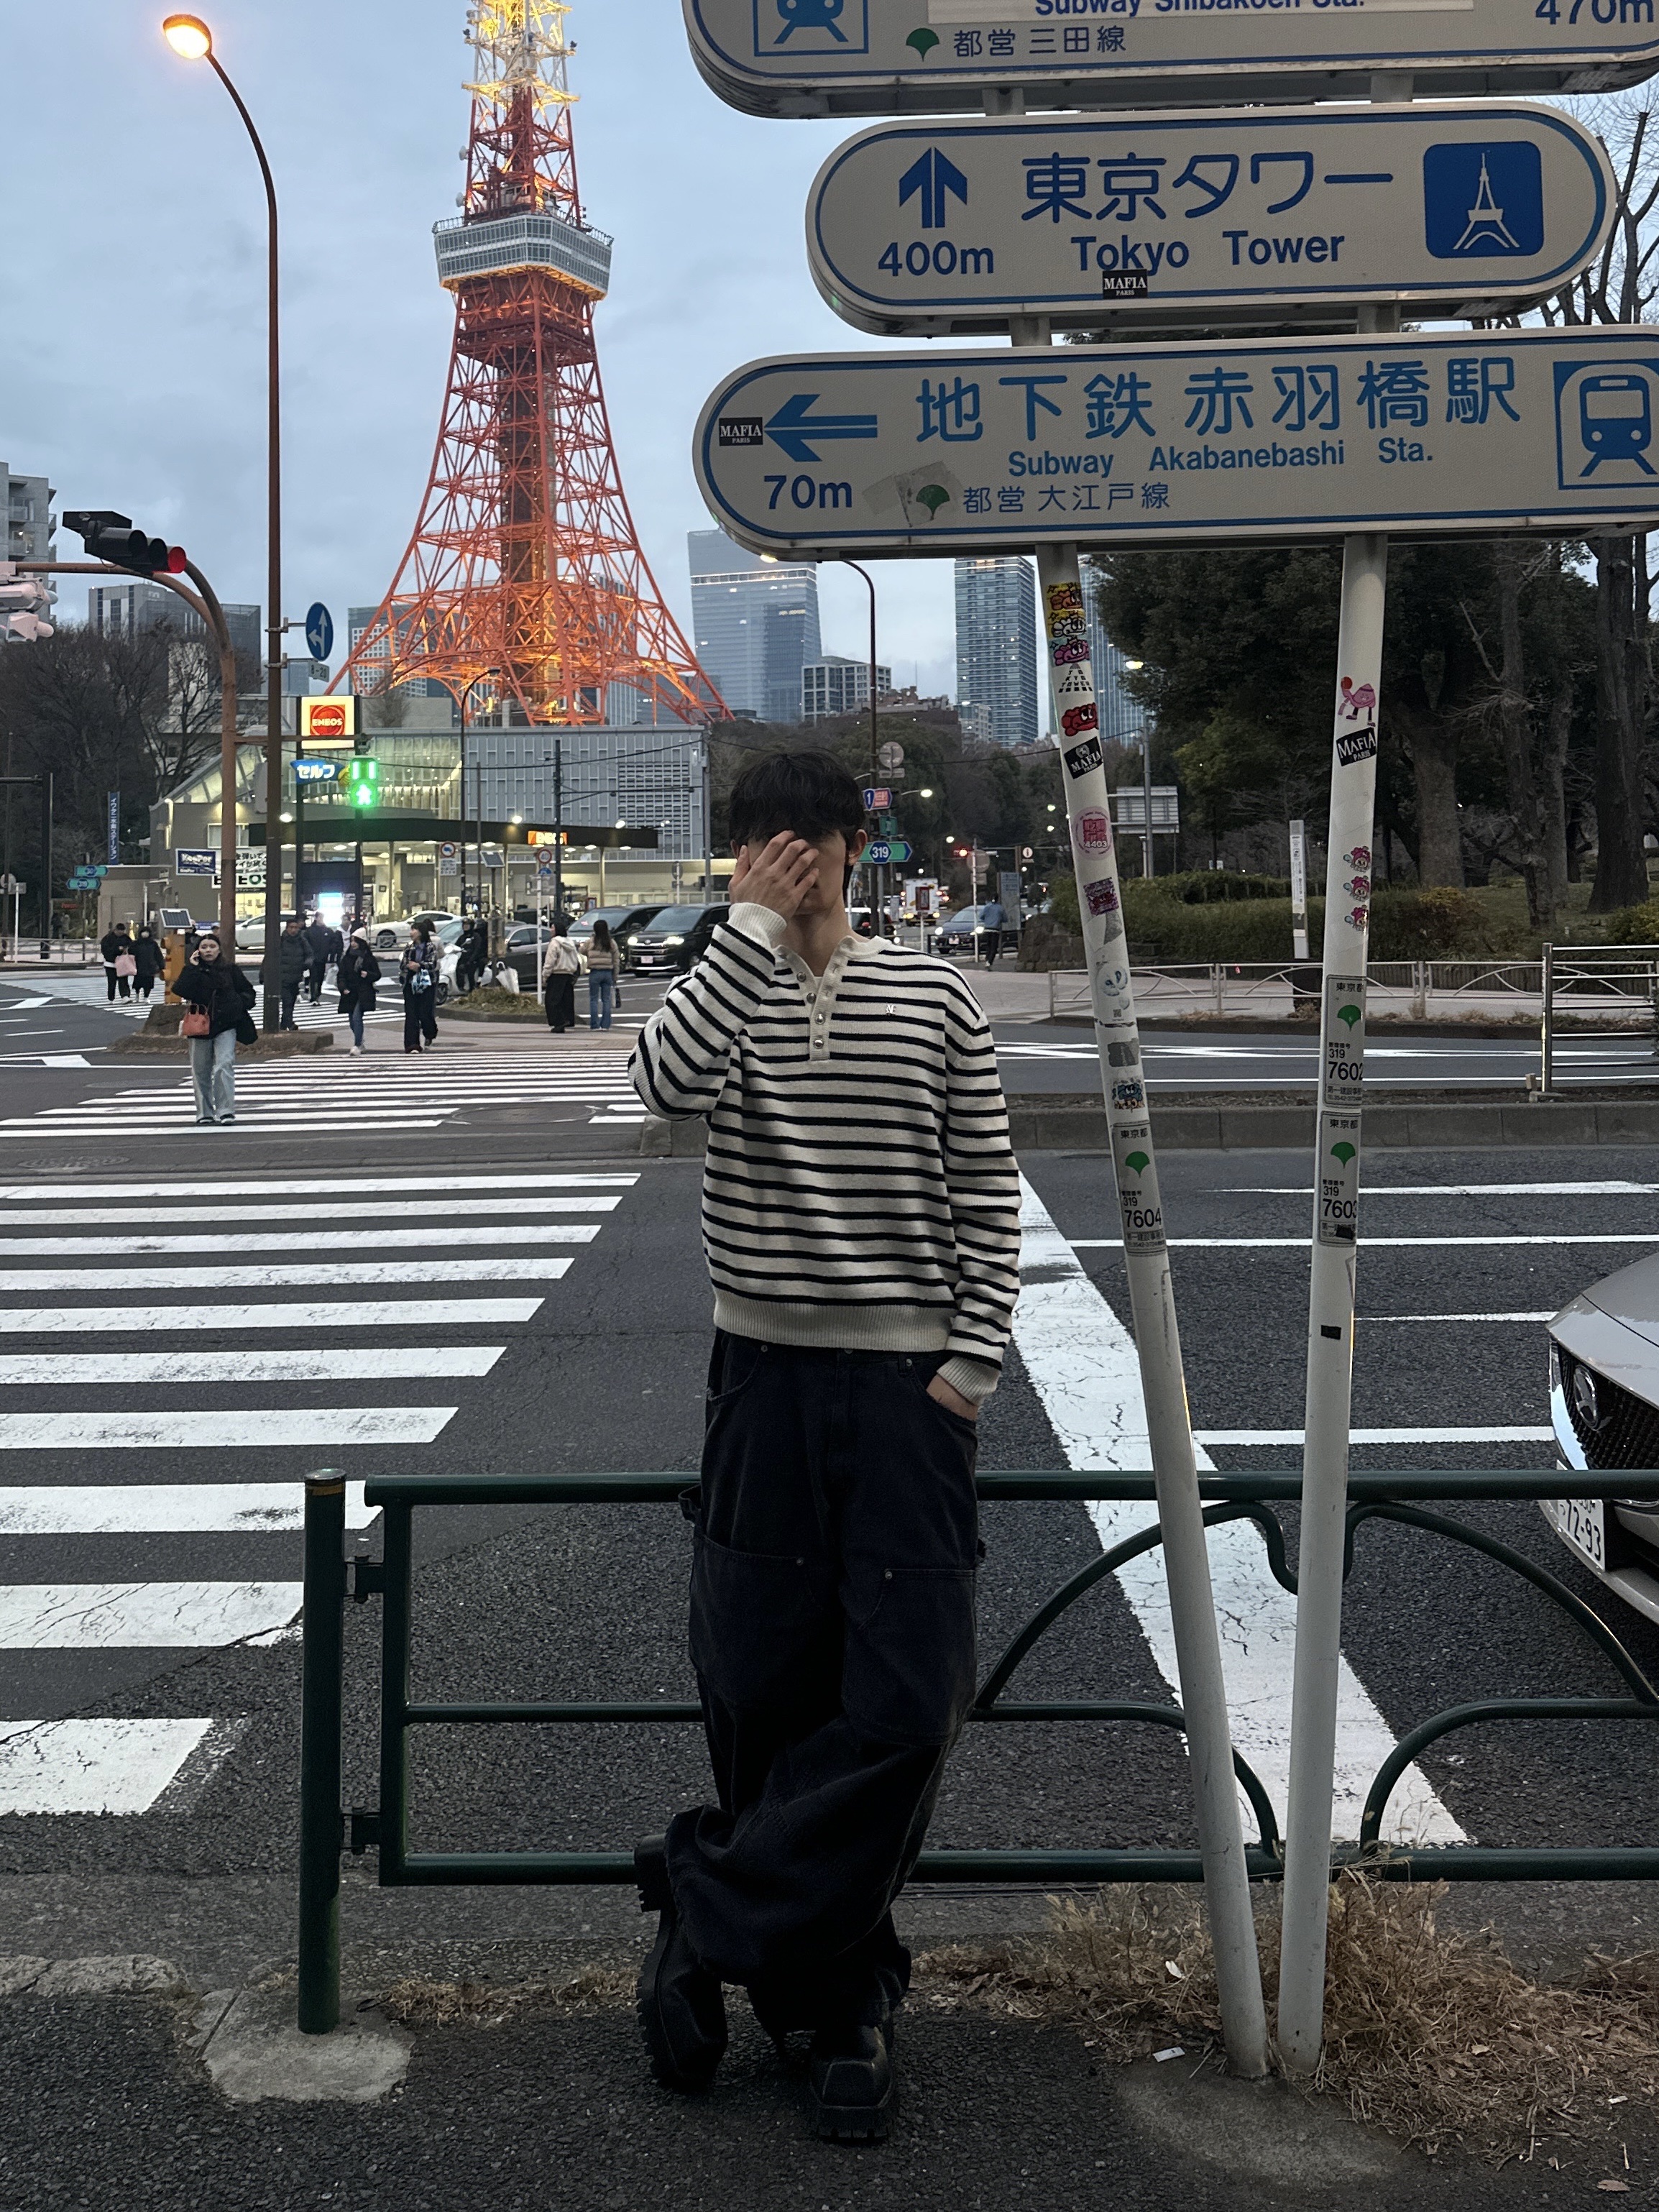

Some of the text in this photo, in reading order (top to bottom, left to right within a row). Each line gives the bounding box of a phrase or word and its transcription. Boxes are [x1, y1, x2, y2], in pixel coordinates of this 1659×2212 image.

[954, 25, 1126, 57] 都営 三田線
[1021, 152, 1394, 224] 東京タワー
[878, 240, 994, 277] 400m
[1070, 230, 1346, 275] Tokyo Tower
[1104, 277, 1147, 290] MAFIA
[915, 357, 1520, 442] 地下鉄 赤羽橋駅
[720, 423, 762, 438] MAFIA
[732, 436, 750, 444] PARIS
[1008, 436, 1433, 477] Subway Akabanebashi Sta.
[763, 474, 853, 510] 70m
[963, 481, 1170, 515] 都営 大江戸線
[1338, 732, 1376, 758] MAFIA
[1071, 751, 1101, 773] MAFIA
[297, 764, 336, 779] セルフ
[867, 792, 871, 805] 1
[872, 847, 889, 858] 319
[1329, 1049, 1346, 1059] 319
[1121, 1127, 1148, 1139] 東京都
[1329, 1119, 1359, 1129] 東京都
[1323, 1185, 1339, 1197] 319
[1123, 1196, 1138, 1207] 319
[1124, 1207, 1162, 1229] 7604
